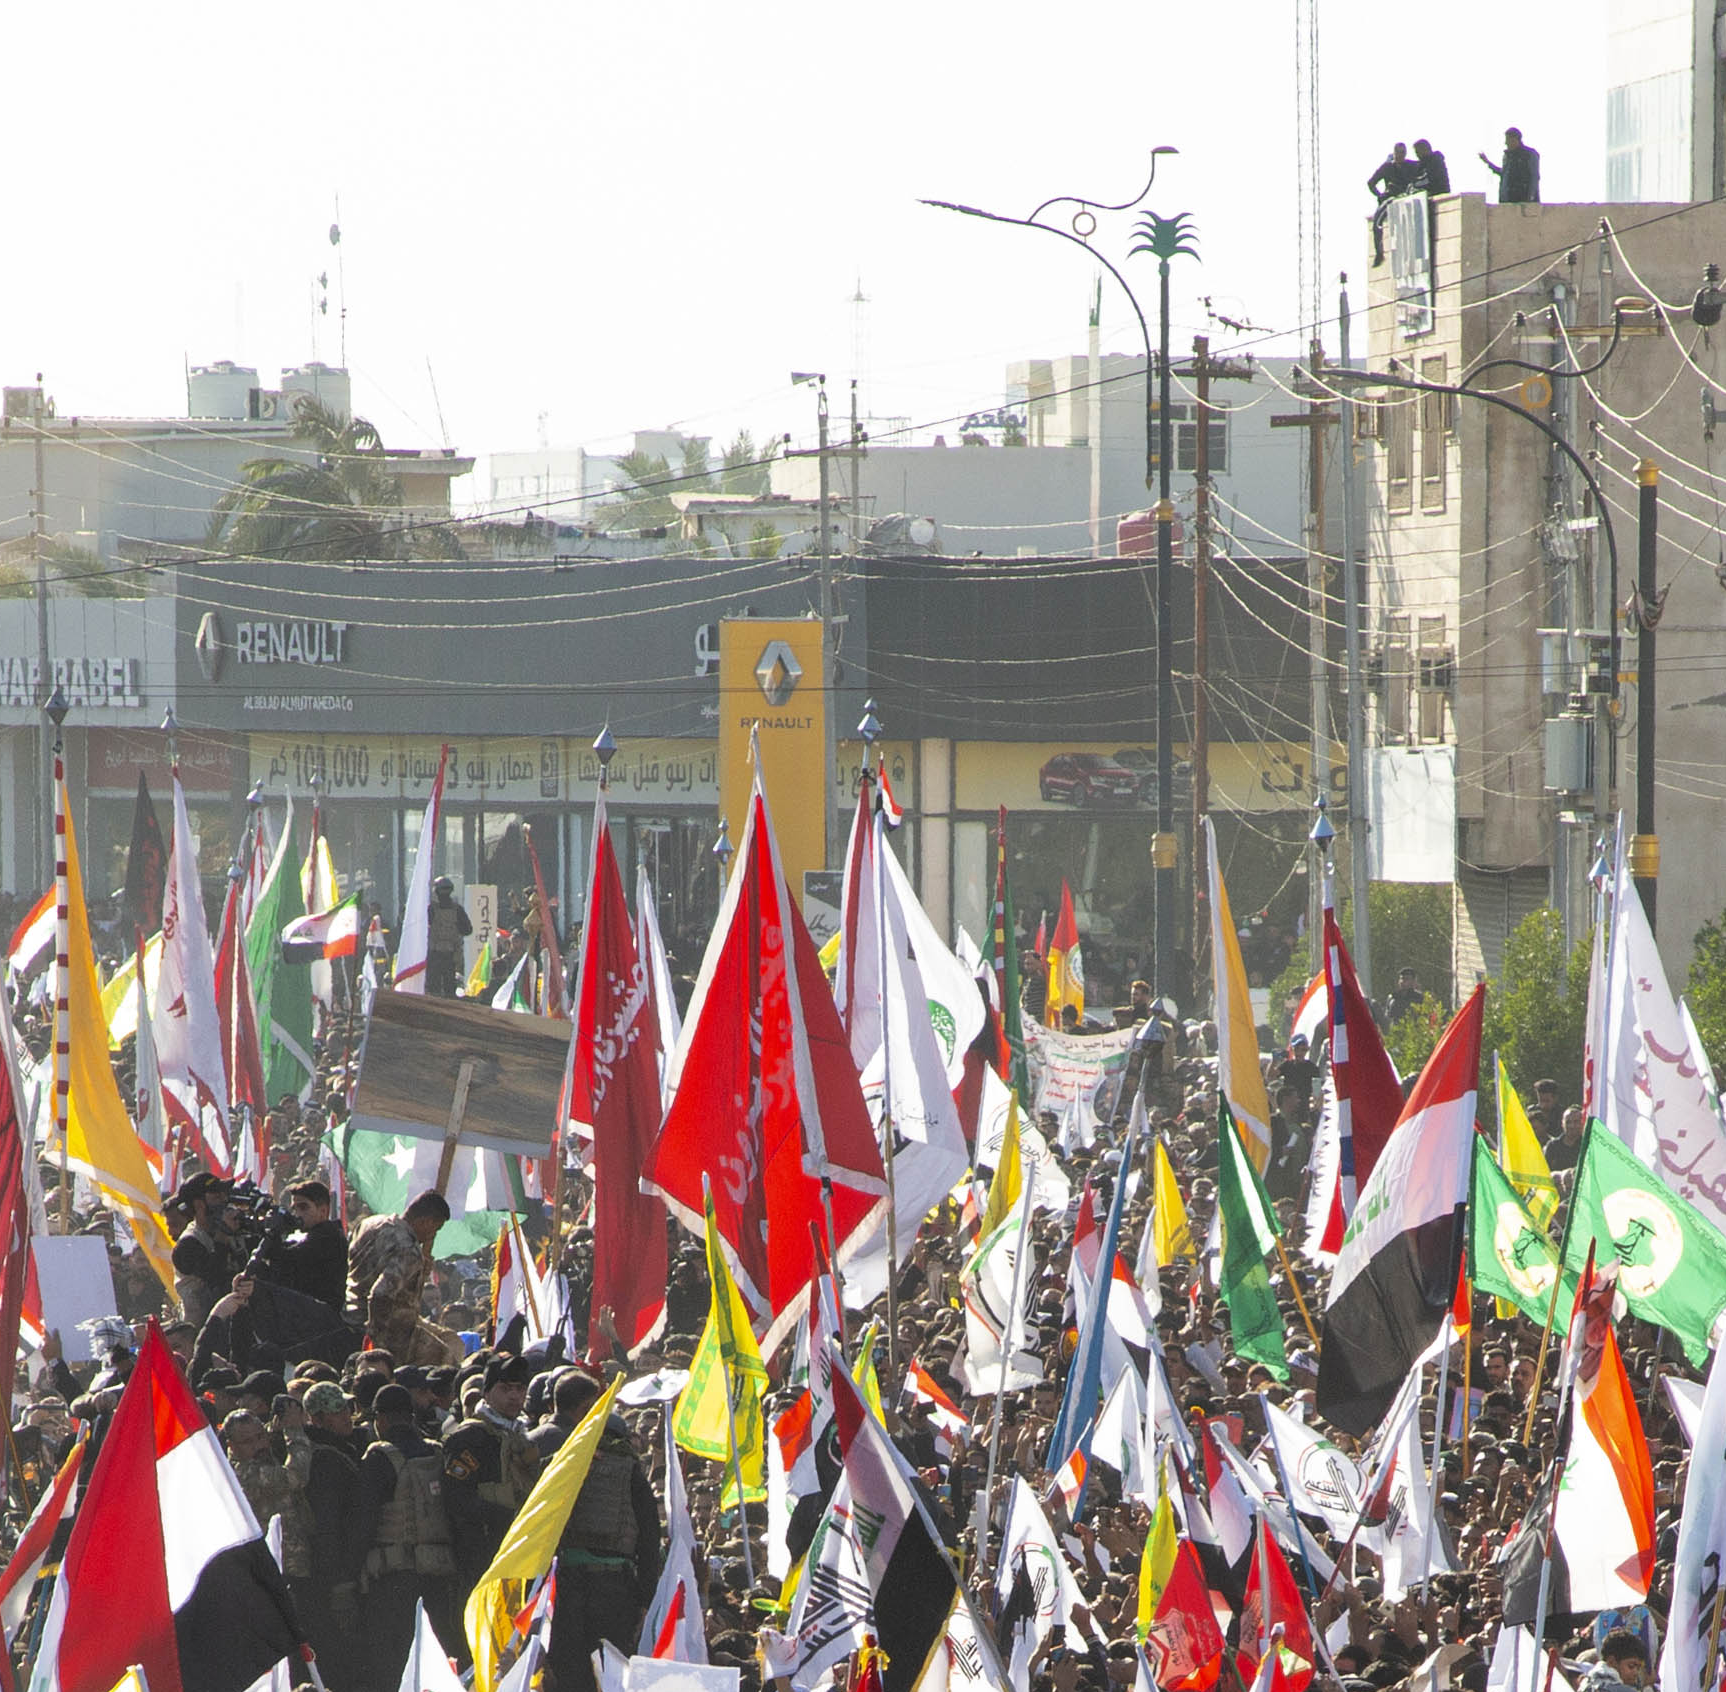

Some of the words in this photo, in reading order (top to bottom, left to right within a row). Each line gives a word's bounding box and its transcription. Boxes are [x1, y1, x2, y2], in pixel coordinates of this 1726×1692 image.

[236, 622, 347, 664] RENAULT
[740, 717, 812, 729] RENAULT
[447, 747, 458, 789] 3
